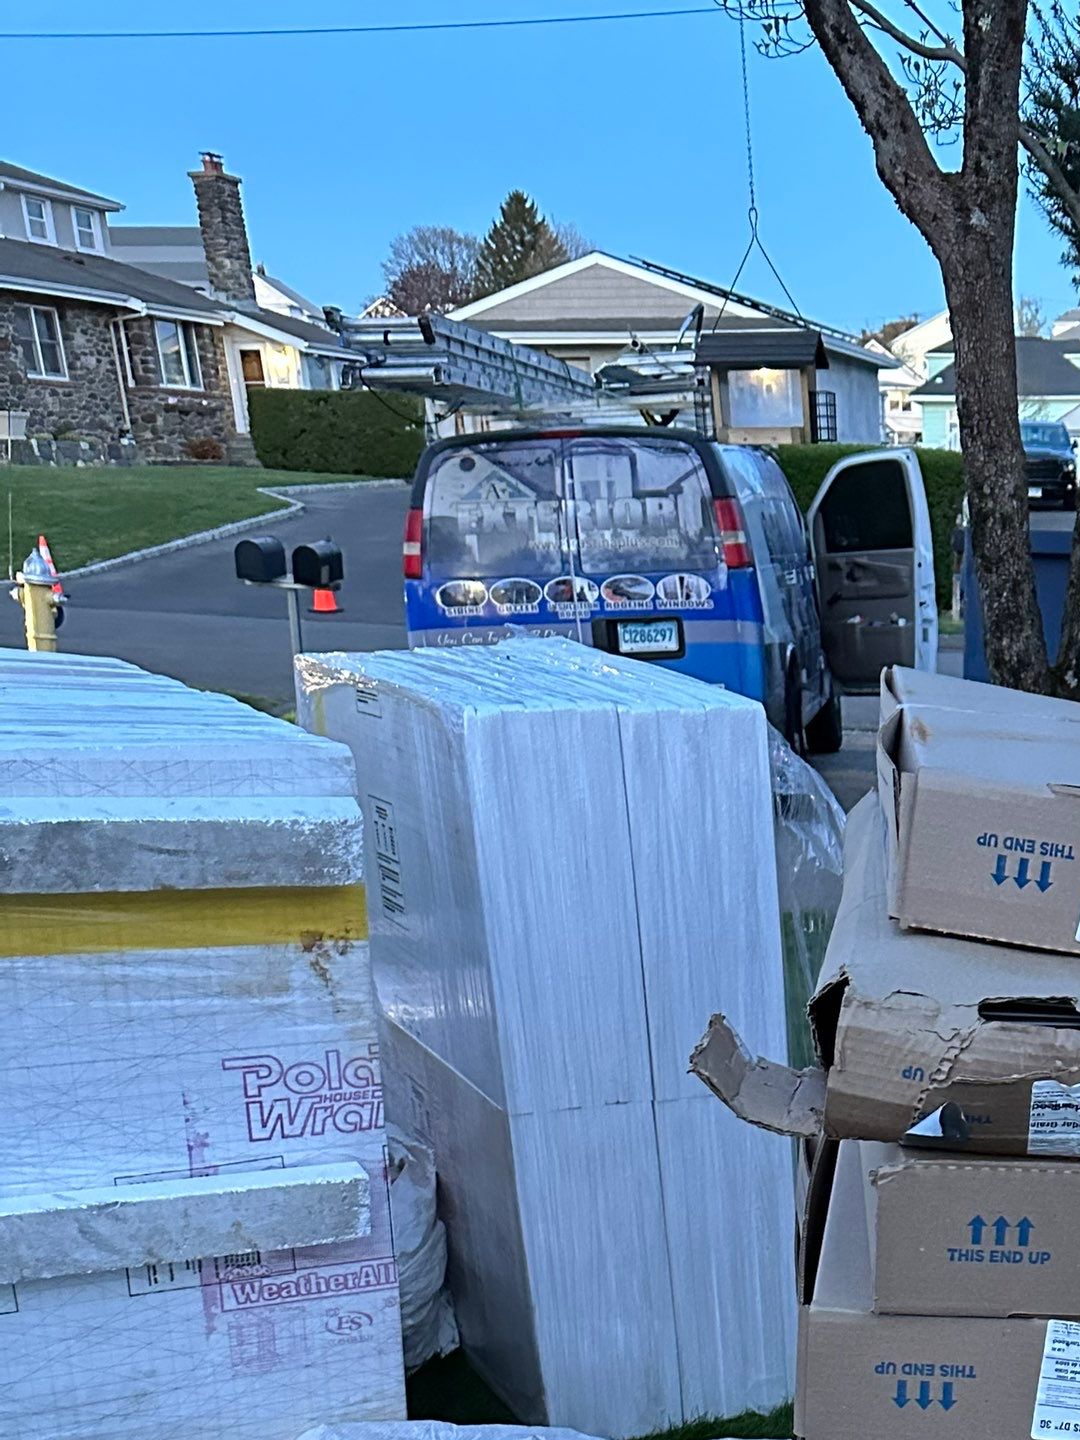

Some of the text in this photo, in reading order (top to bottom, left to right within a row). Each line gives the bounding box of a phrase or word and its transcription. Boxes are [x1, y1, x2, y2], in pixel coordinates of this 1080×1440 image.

[656, 599, 715, 610] WINDOWS
[975, 831, 1076, 859] THIS END UP
[901, 1065, 925, 1082] UP
[322, 1089, 371, 1105] HOUSE
[947, 1248, 1051, 1265] THIS END UP
[232, 1262, 398, 1306] WeatherAll
[336, 1315, 364, 1331] ES
[874, 1361, 976, 1378] THIS END UP
